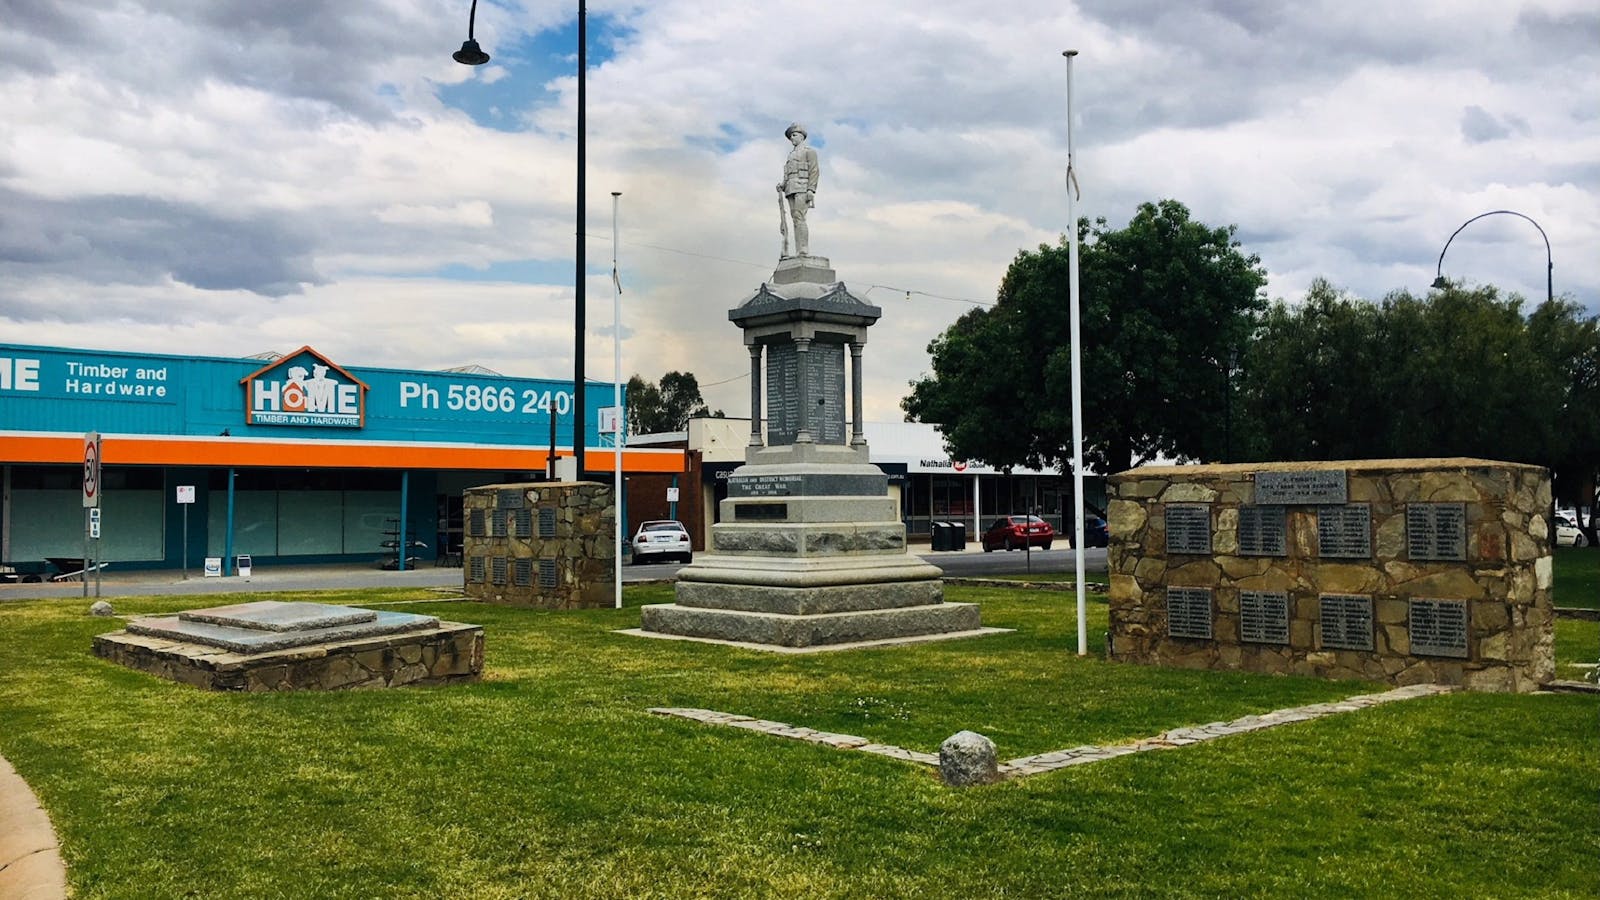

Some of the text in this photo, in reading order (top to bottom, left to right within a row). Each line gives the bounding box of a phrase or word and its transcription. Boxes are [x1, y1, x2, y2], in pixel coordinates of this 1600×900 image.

[66, 362, 167, 381] Timber and
[65, 379, 167, 397] Hardware
[255, 379, 358, 414] HOME
[400, 381, 440, 409] Ph
[447, 384, 516, 413] 5866
[256, 414, 358, 426] TIMBER AND HARDWARE
[85, 458, 95, 483] 50
